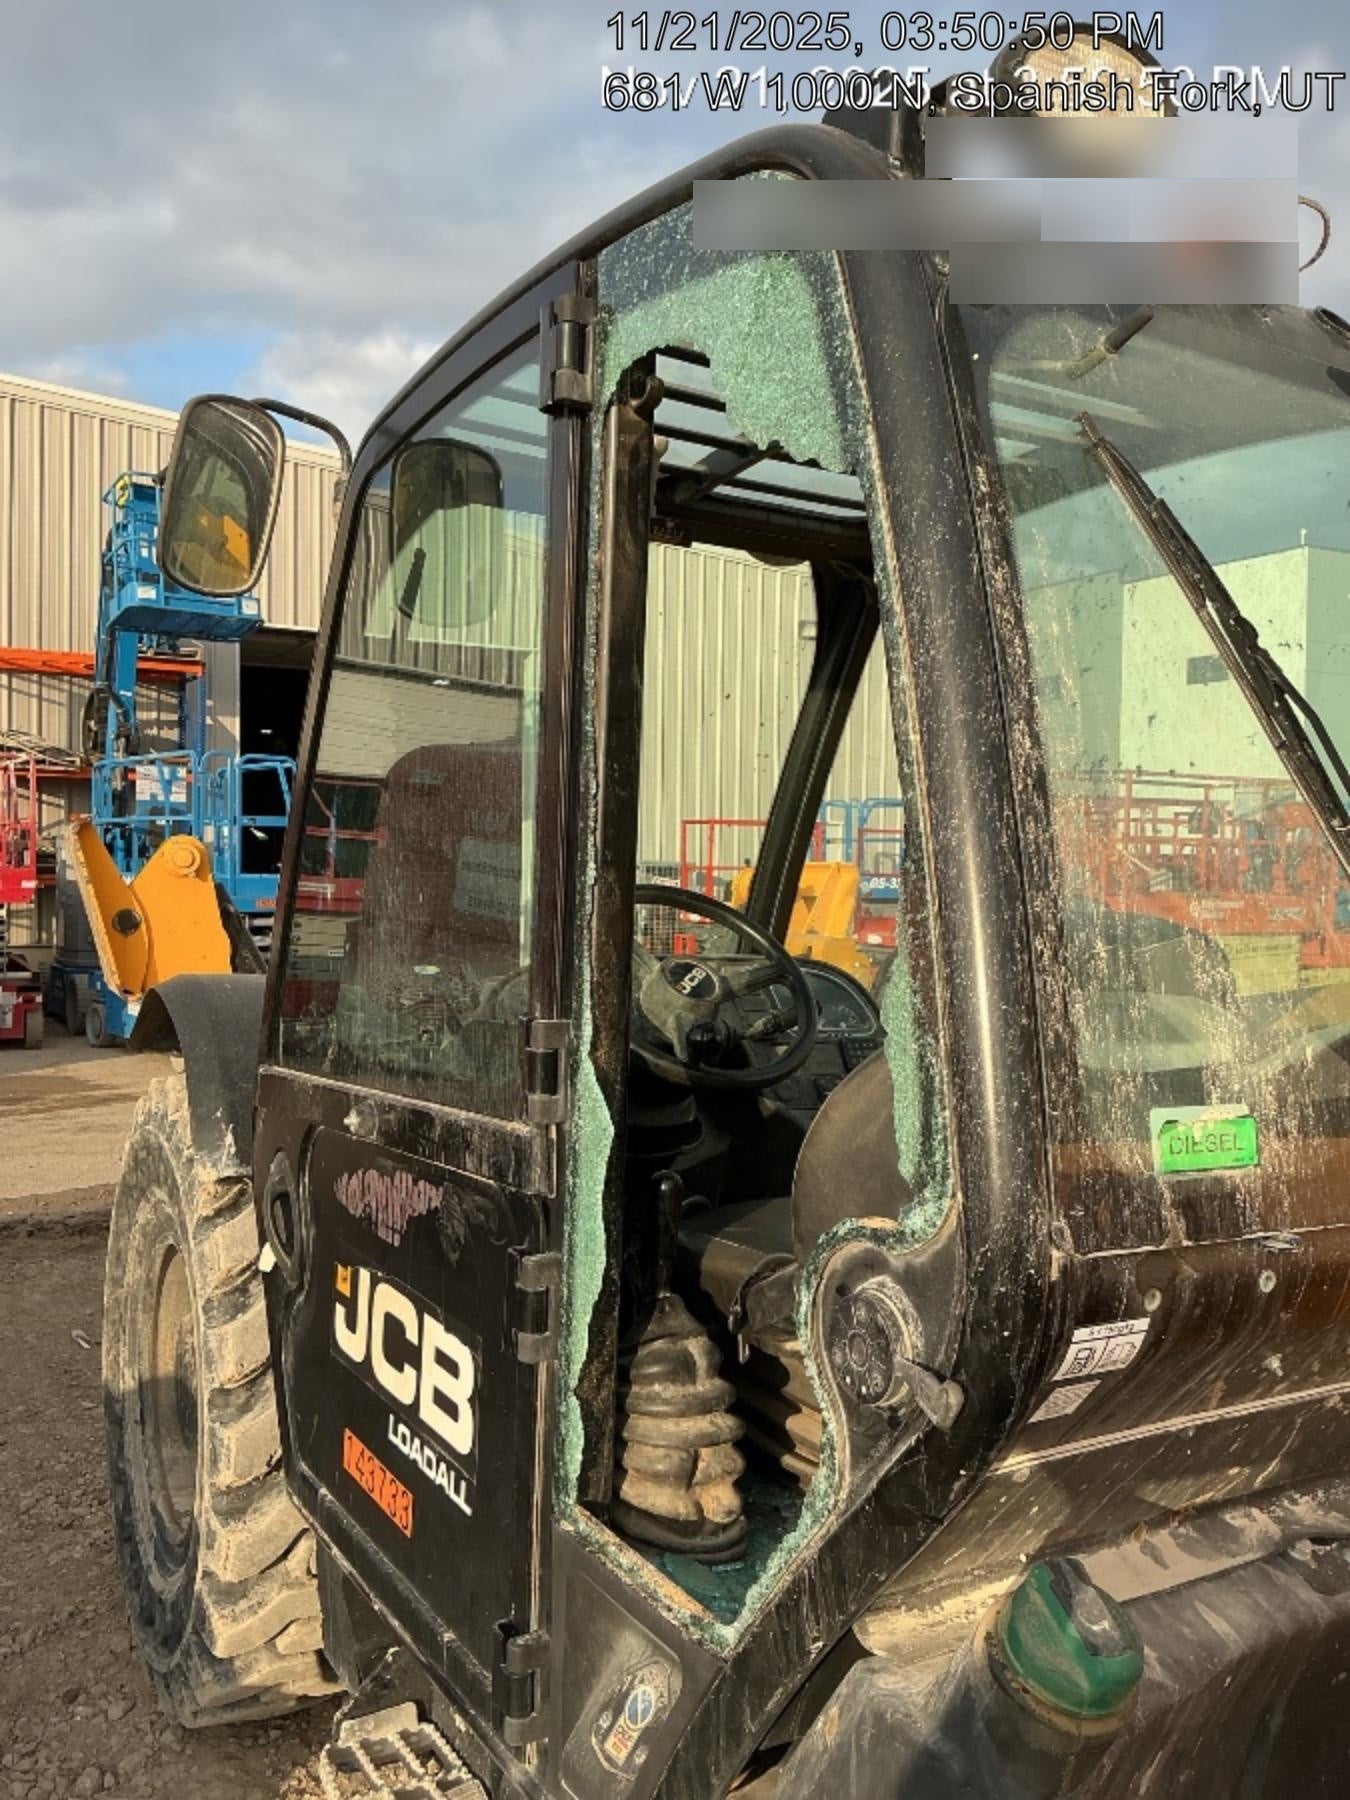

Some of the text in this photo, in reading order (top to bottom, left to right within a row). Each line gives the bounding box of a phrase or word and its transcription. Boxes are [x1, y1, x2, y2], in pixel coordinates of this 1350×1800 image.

[673, 967, 707, 995] JCB
[1169, 1132, 1246, 1155] DIESEL
[334, 1265, 475, 1455] JCB
[345, 1433, 411, 1531] 143733
[388, 1412, 472, 1517] LOADALL
